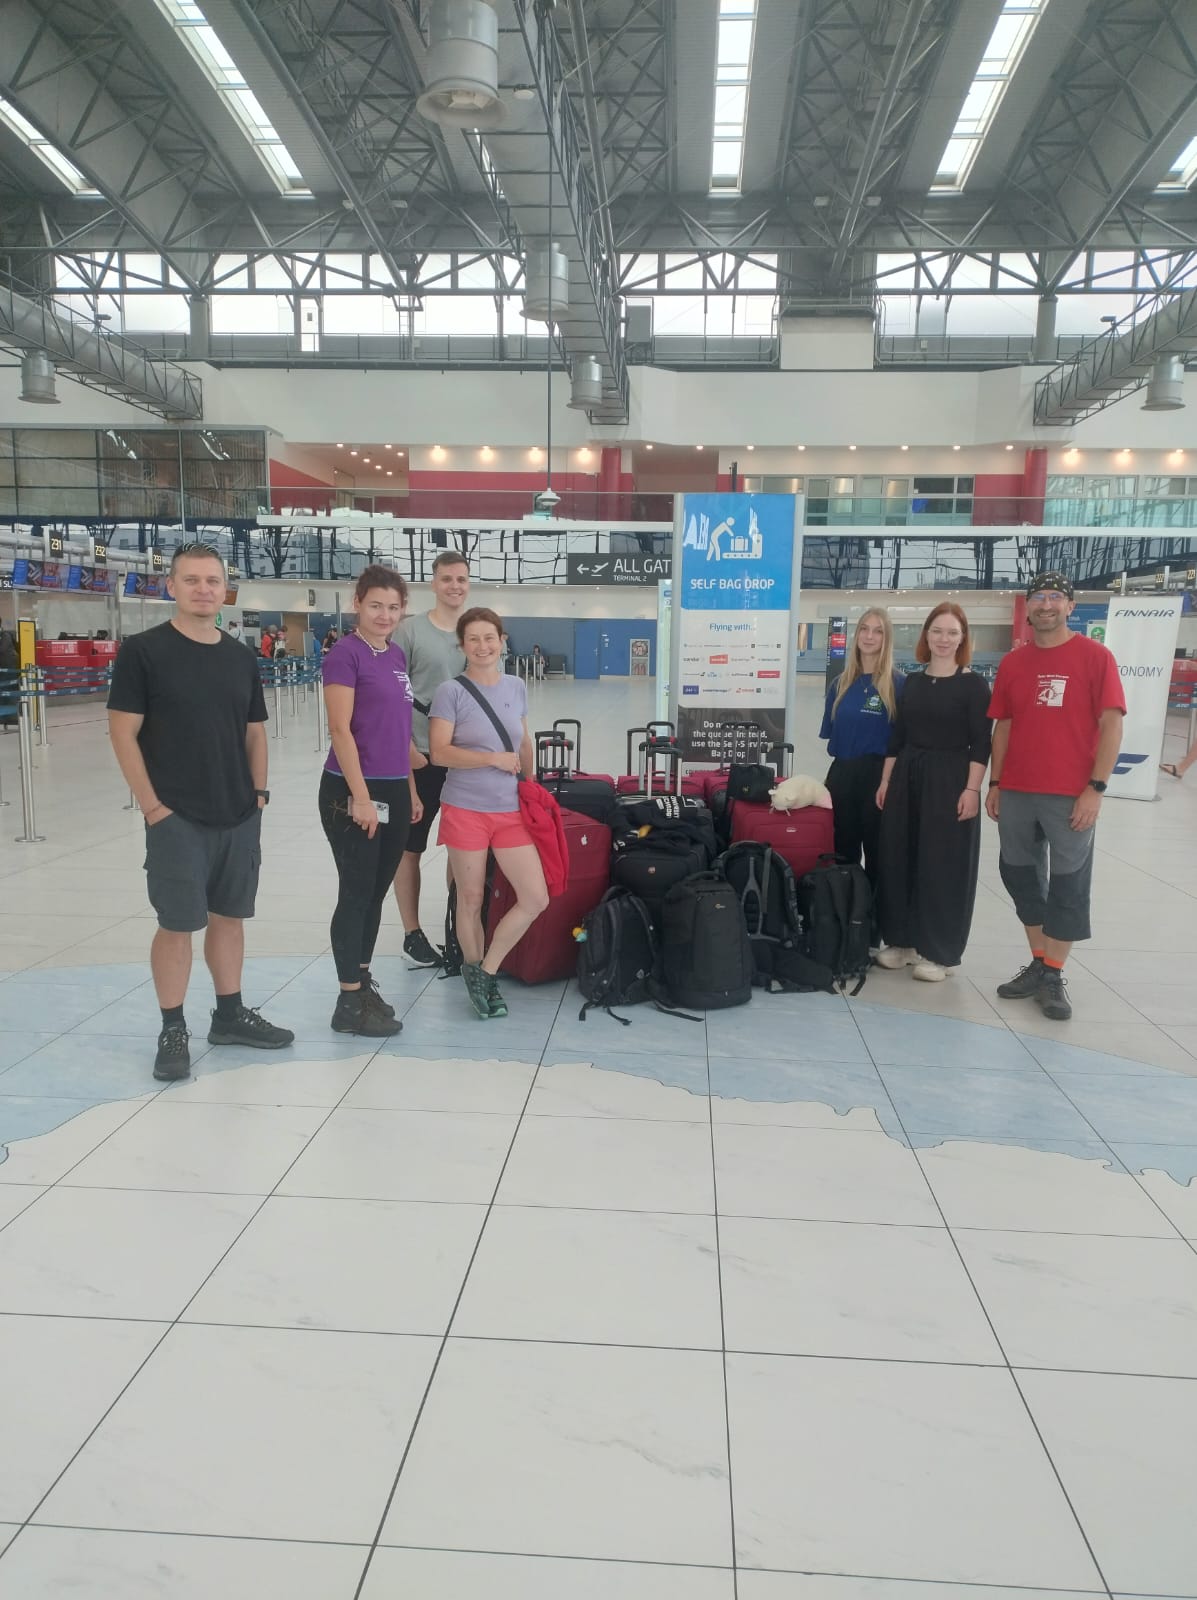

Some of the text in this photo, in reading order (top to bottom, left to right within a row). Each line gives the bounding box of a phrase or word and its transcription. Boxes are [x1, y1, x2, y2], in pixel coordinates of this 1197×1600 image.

[613, 558, 640, 573] ALL
[690, 578, 775, 589] SELF BAG DROP
[1115, 609, 1175, 617] FINNAIR
[709, 623, 732, 631] Flying
[1116, 665, 1164, 678] ONOMY
[703, 720, 714, 728] Do
[693, 730, 707, 738] the
[708, 740, 721, 748] the
[728, 750, 746, 758] Dop
